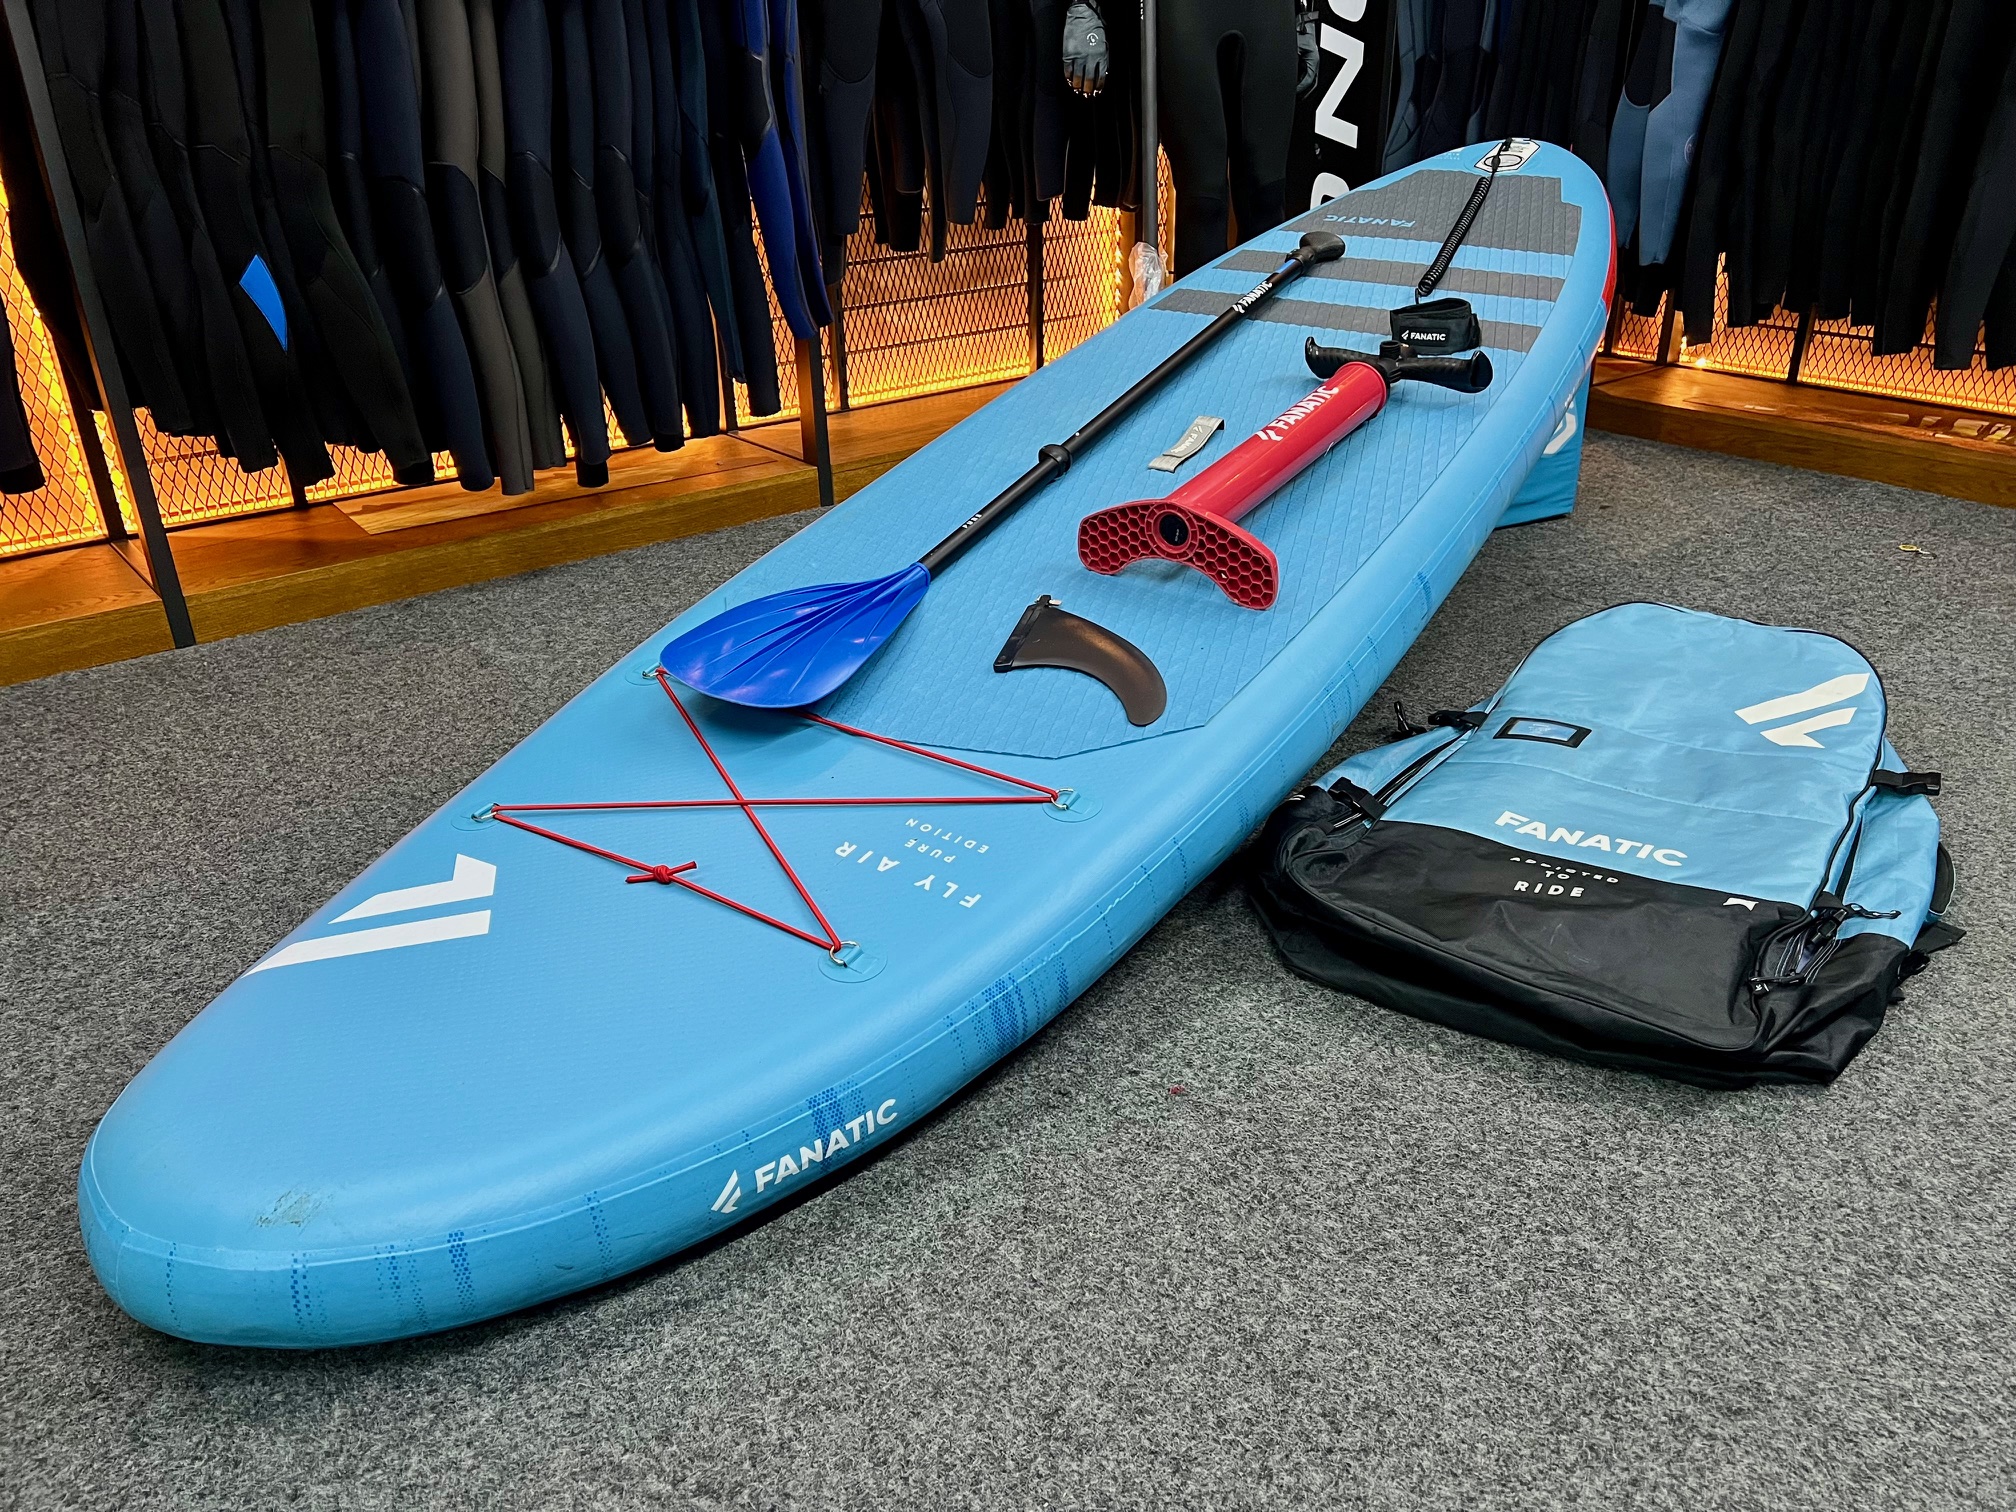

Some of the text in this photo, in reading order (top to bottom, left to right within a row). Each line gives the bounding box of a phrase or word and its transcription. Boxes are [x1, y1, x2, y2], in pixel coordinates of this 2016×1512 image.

[1323, 214, 1416, 229] FANATIC
[1238, 280, 1273, 307] FANATIC
[1410, 332, 1446, 341] FANATIC
[1270, 385, 1340, 430] FANATIC
[1170, 433, 1198, 454] FANA
[905, 818, 990, 854] EDITION
[1495, 811, 1688, 867] FANATIC
[904, 838, 956, 864] PURE
[834, 841, 982, 909] FLY AIR
[1545, 870, 1570, 880] TO
[1513, 880, 1585, 898] RIDE
[754, 1098, 898, 1194] FANATIC
